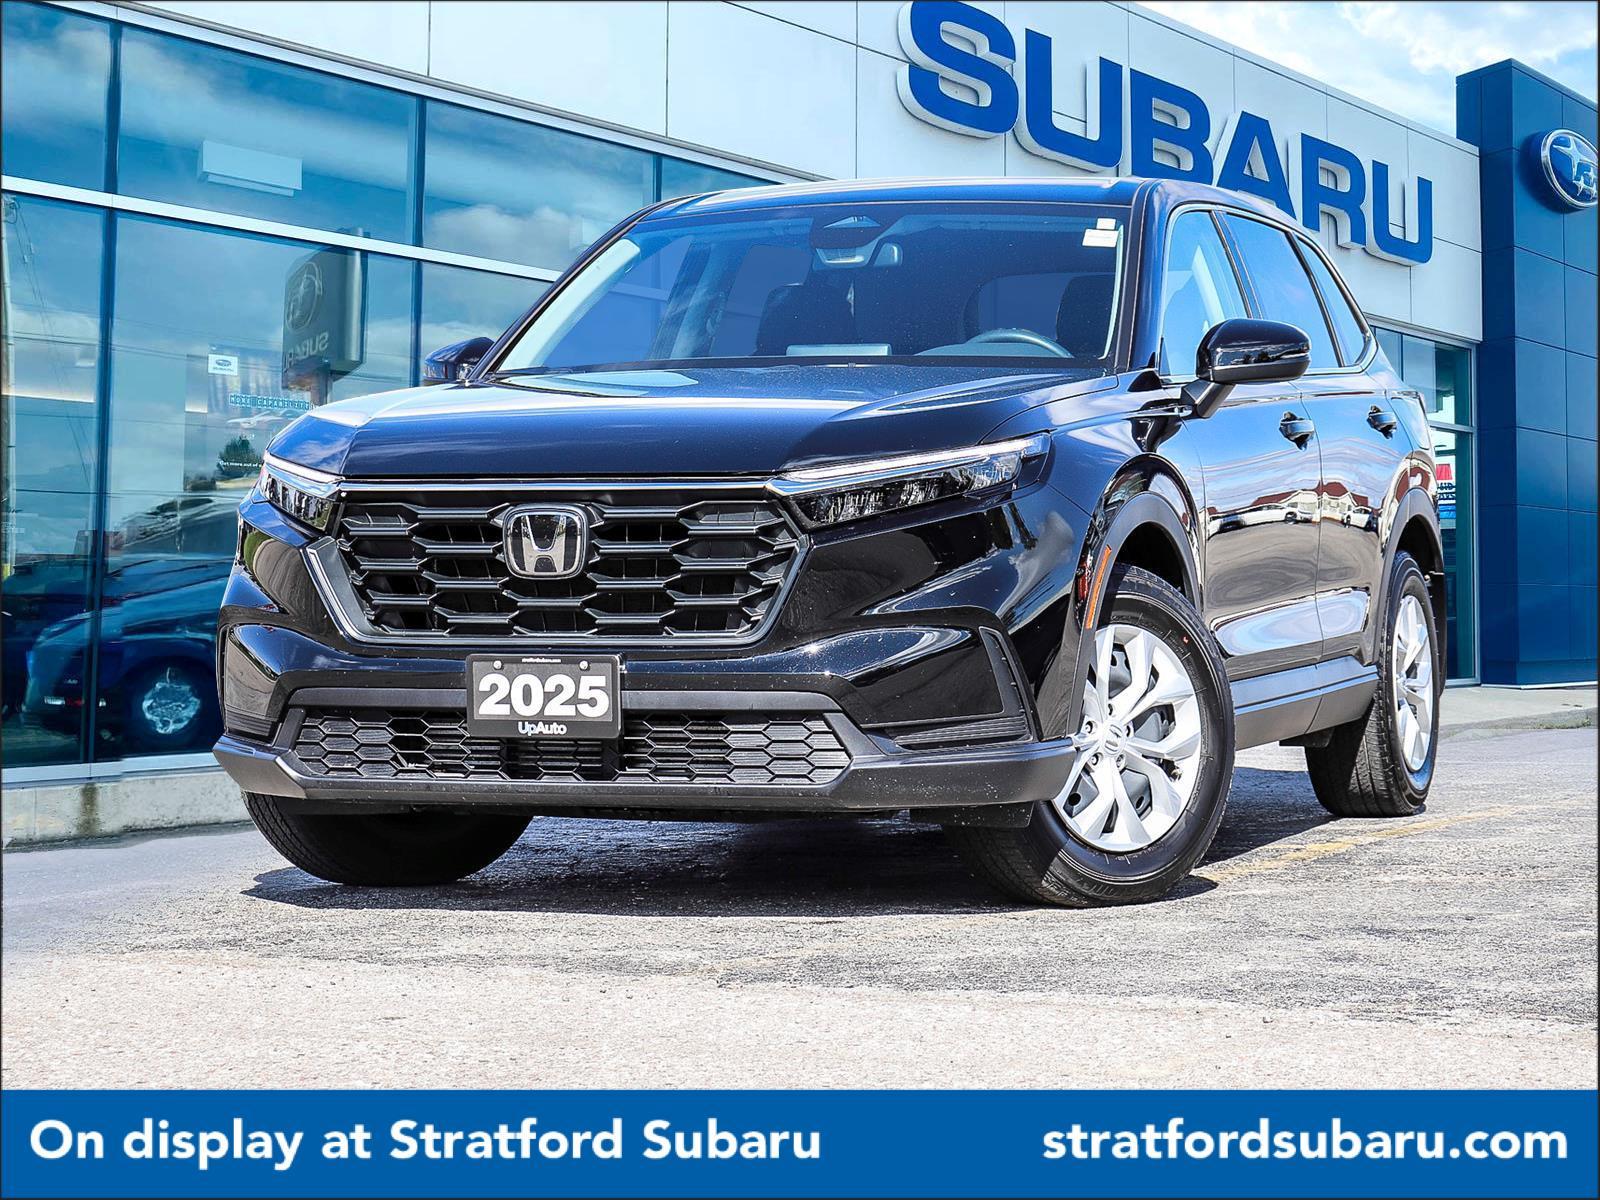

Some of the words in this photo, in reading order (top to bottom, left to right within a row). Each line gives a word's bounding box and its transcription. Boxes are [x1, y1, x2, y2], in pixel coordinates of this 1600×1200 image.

[897, 0, 1434, 266] SUBARU
[478, 673, 610, 718] 2025
[518, 721, 568, 736] UpAuto
